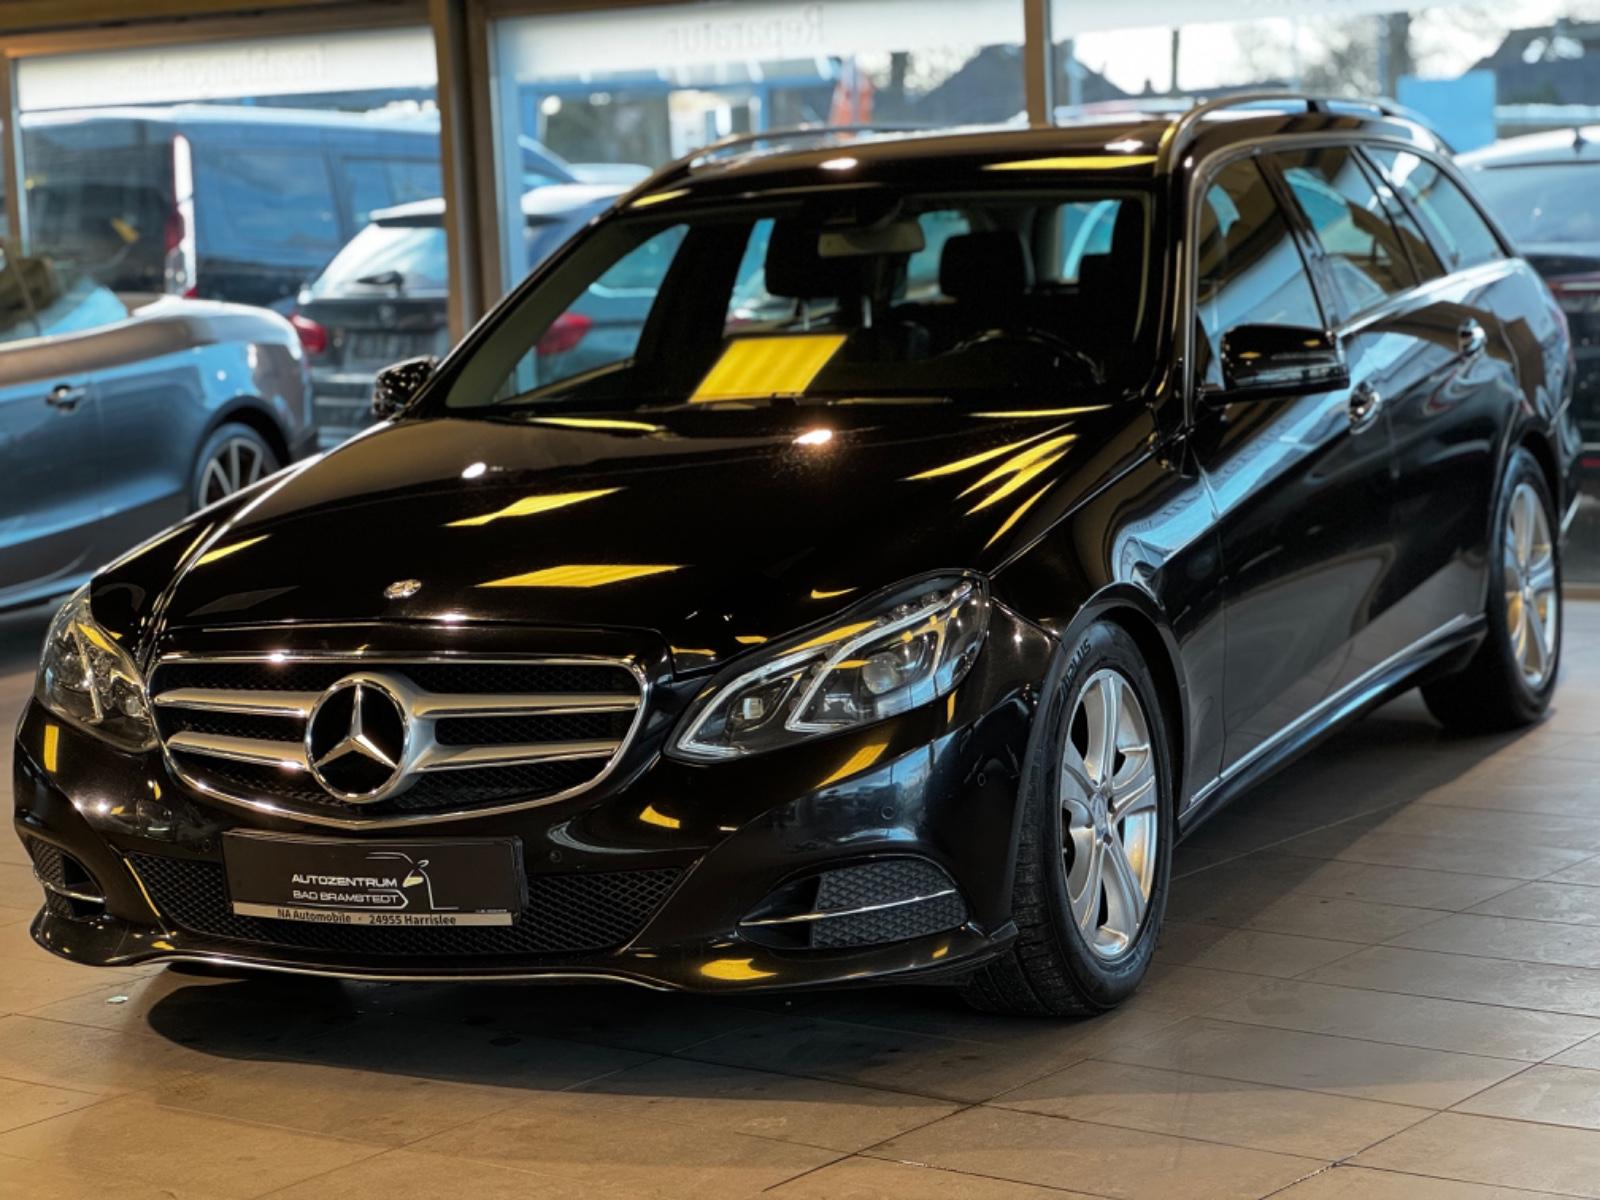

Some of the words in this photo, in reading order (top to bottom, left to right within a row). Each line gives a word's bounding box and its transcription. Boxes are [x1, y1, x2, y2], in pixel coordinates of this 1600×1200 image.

[291, 874, 398, 888] AUTOZENTRUM
[292, 889, 318, 900] BAD
[320, 892, 399, 904] BRAMSTEDT
[277, 908, 291, 919] NA
[293, 910, 352, 923] Automobile
[369, 914, 402, 925] 24955
[404, 914, 456, 925] Harrislee
